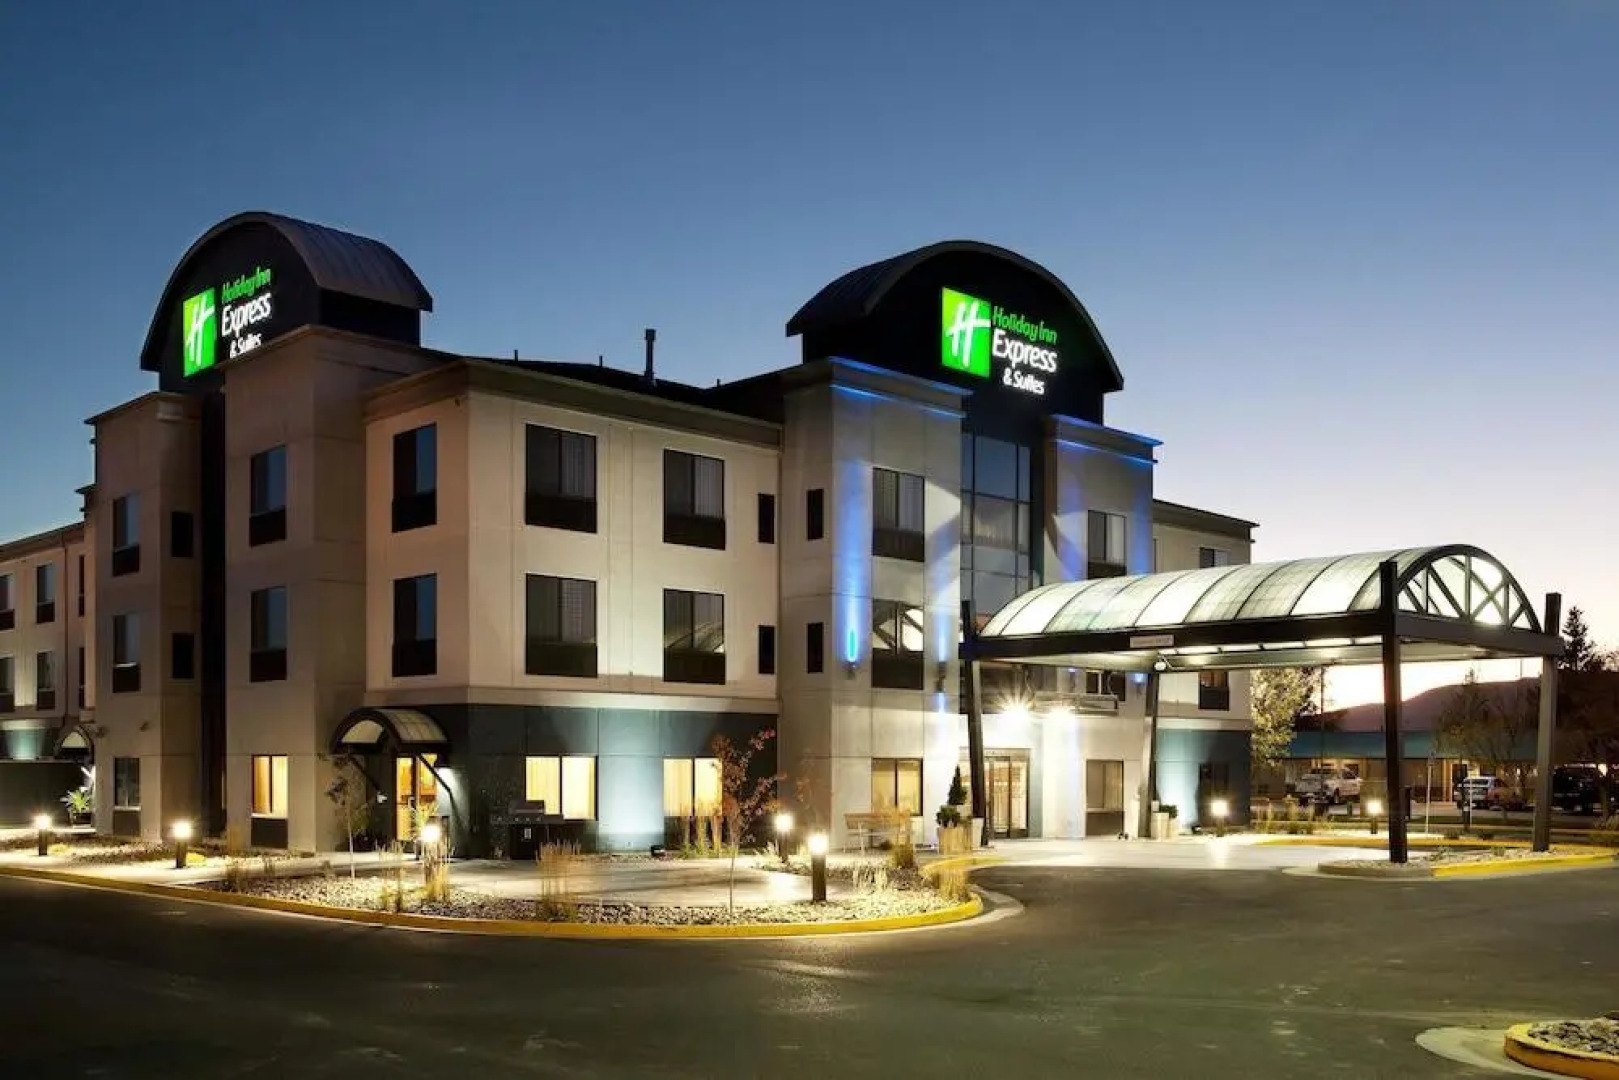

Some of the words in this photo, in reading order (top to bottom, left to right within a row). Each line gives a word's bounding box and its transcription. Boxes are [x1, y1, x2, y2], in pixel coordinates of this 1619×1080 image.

[221, 292, 272, 338] Express
[993, 305, 1039, 342] Holiday
[1040, 320, 1058, 345] Inn
[992, 328, 1058, 373] Express
[1003, 367, 1013, 386] &
[1013, 370, 1046, 395] Suites
